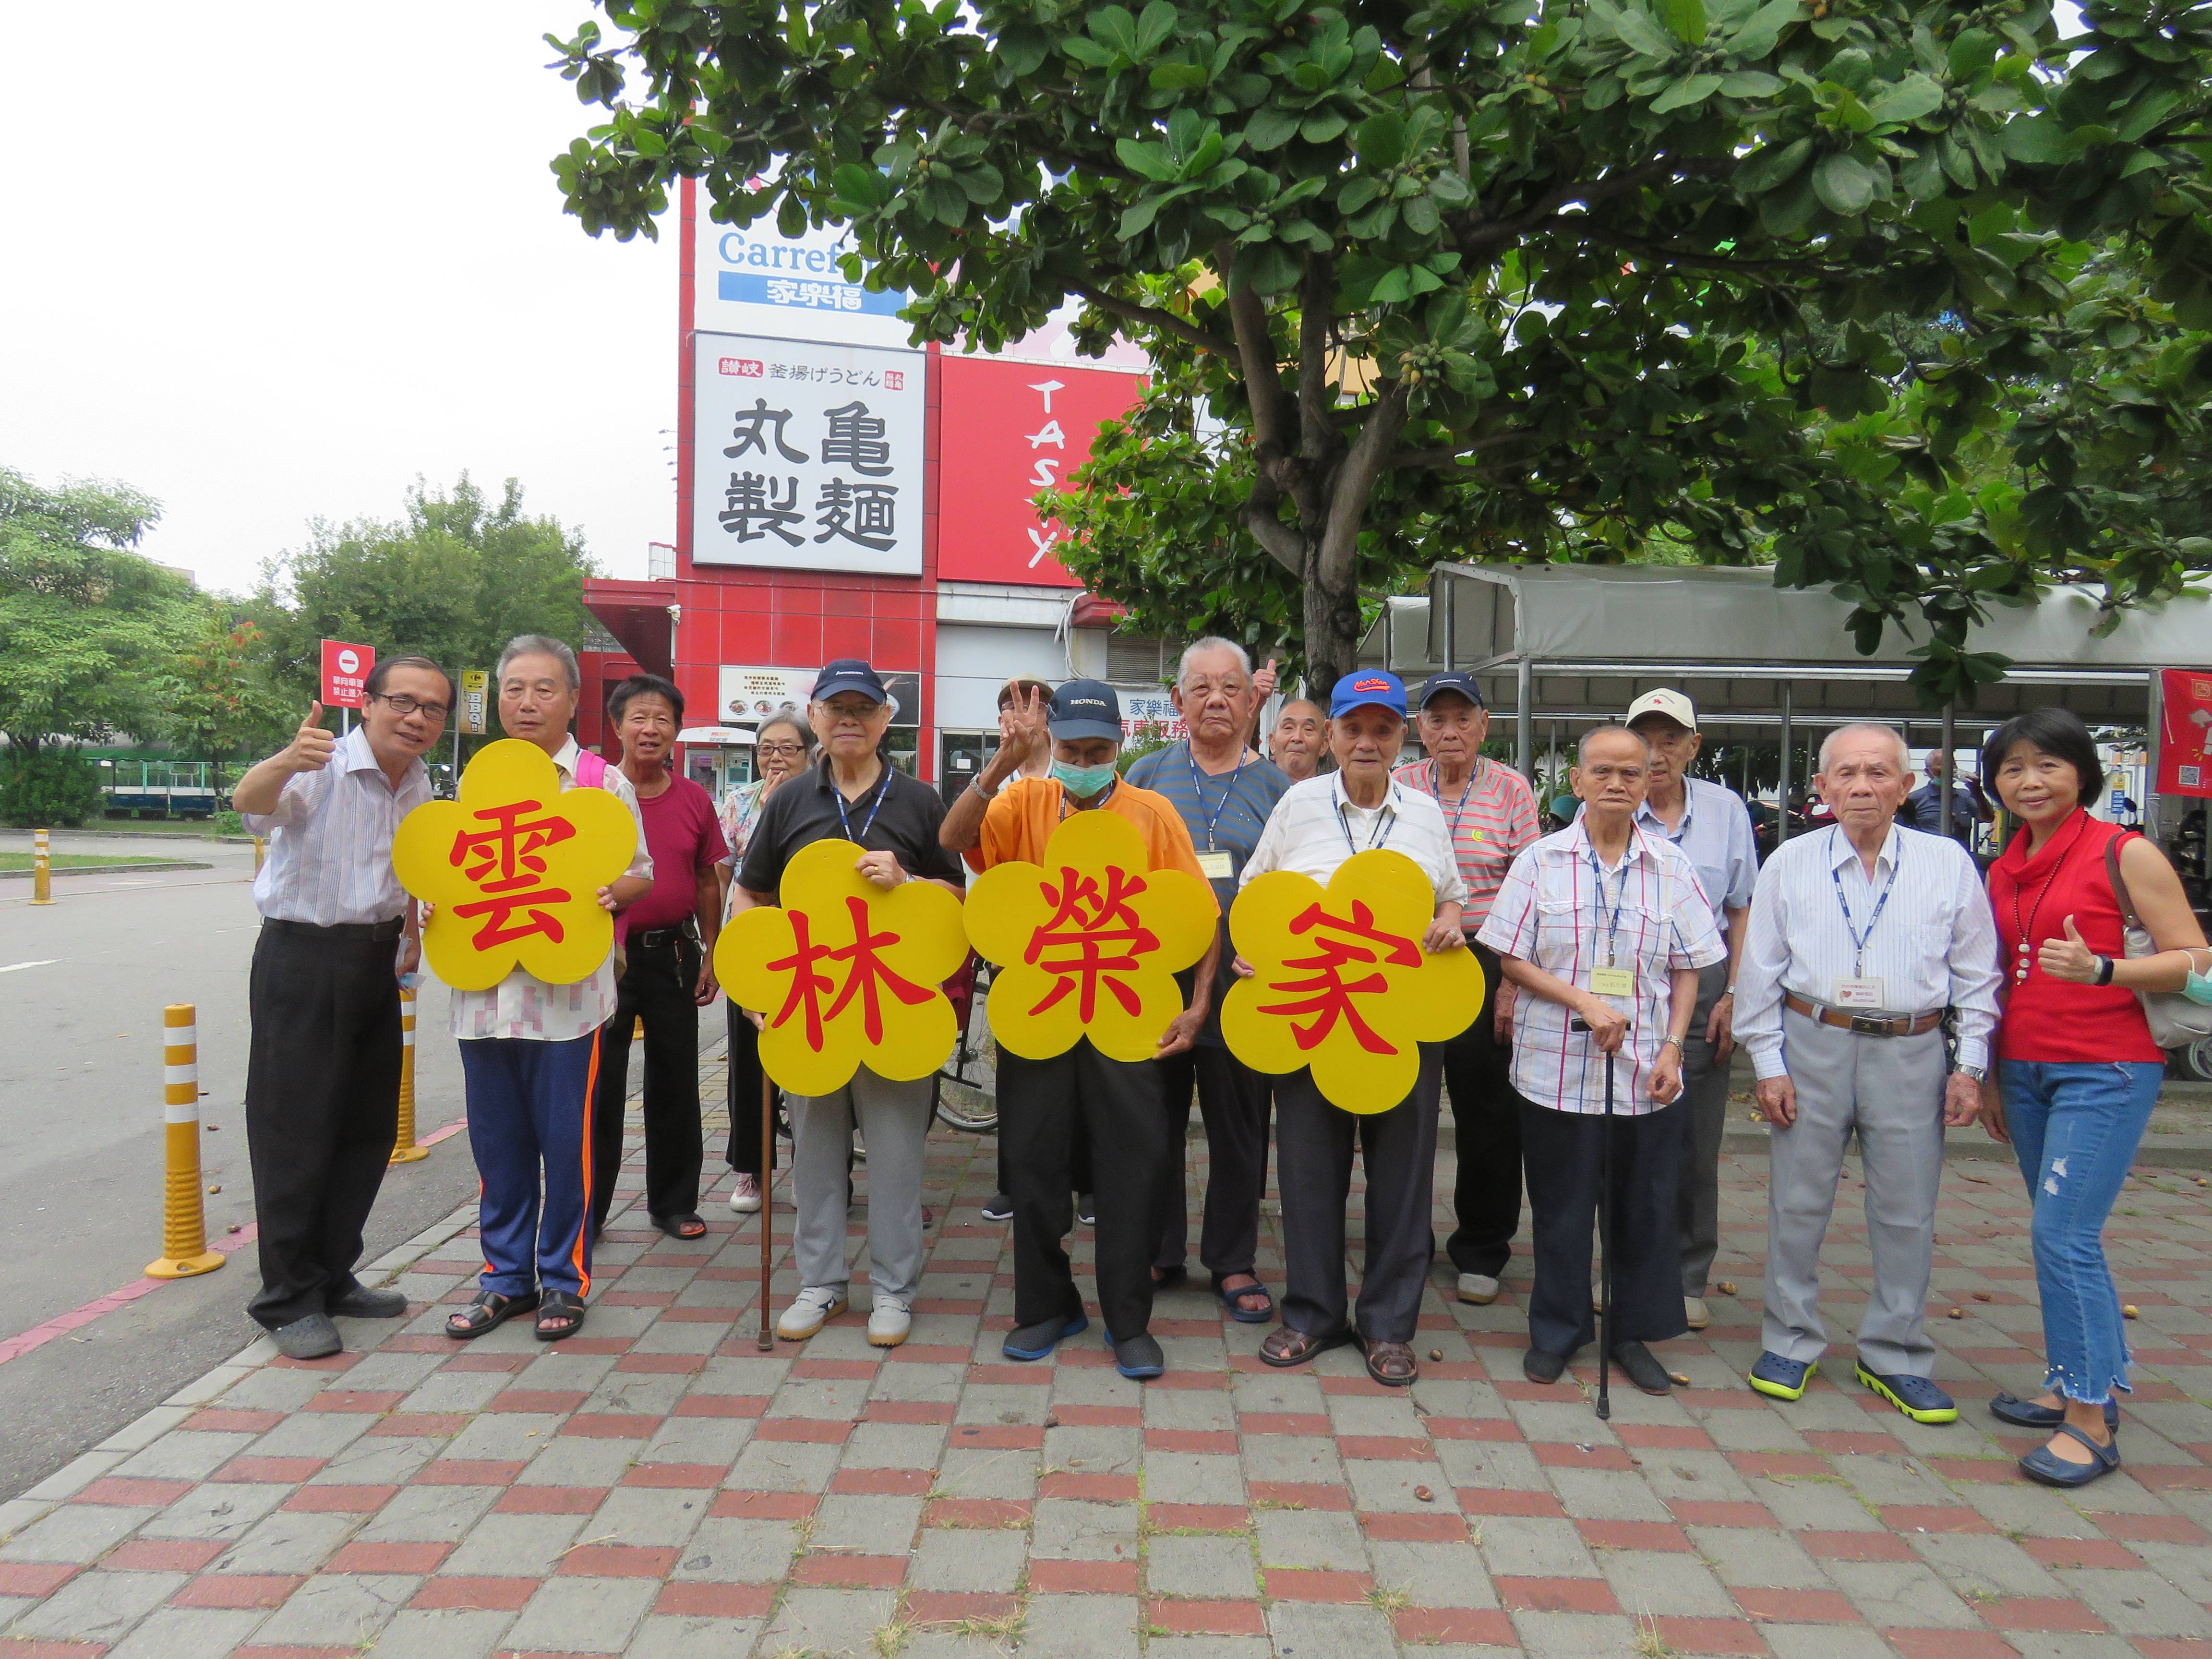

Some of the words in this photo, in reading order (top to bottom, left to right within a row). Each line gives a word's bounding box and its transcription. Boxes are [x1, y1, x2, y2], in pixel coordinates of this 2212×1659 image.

[719, 232, 873, 274] Carref
[767, 280, 862, 310] 家樂福
[768, 363, 880, 386] 釜揚げうどん
[332, 686, 363, 697] 禁止進入
[468, 692, 482, 725] BBQ
[1070, 698, 1107, 707] HONDA
[449, 799, 577, 952] 雲
[1023, 865, 1161, 1024] 榮
[766, 895, 937, 1053] 林
[1256, 899, 1423, 1056] 家
